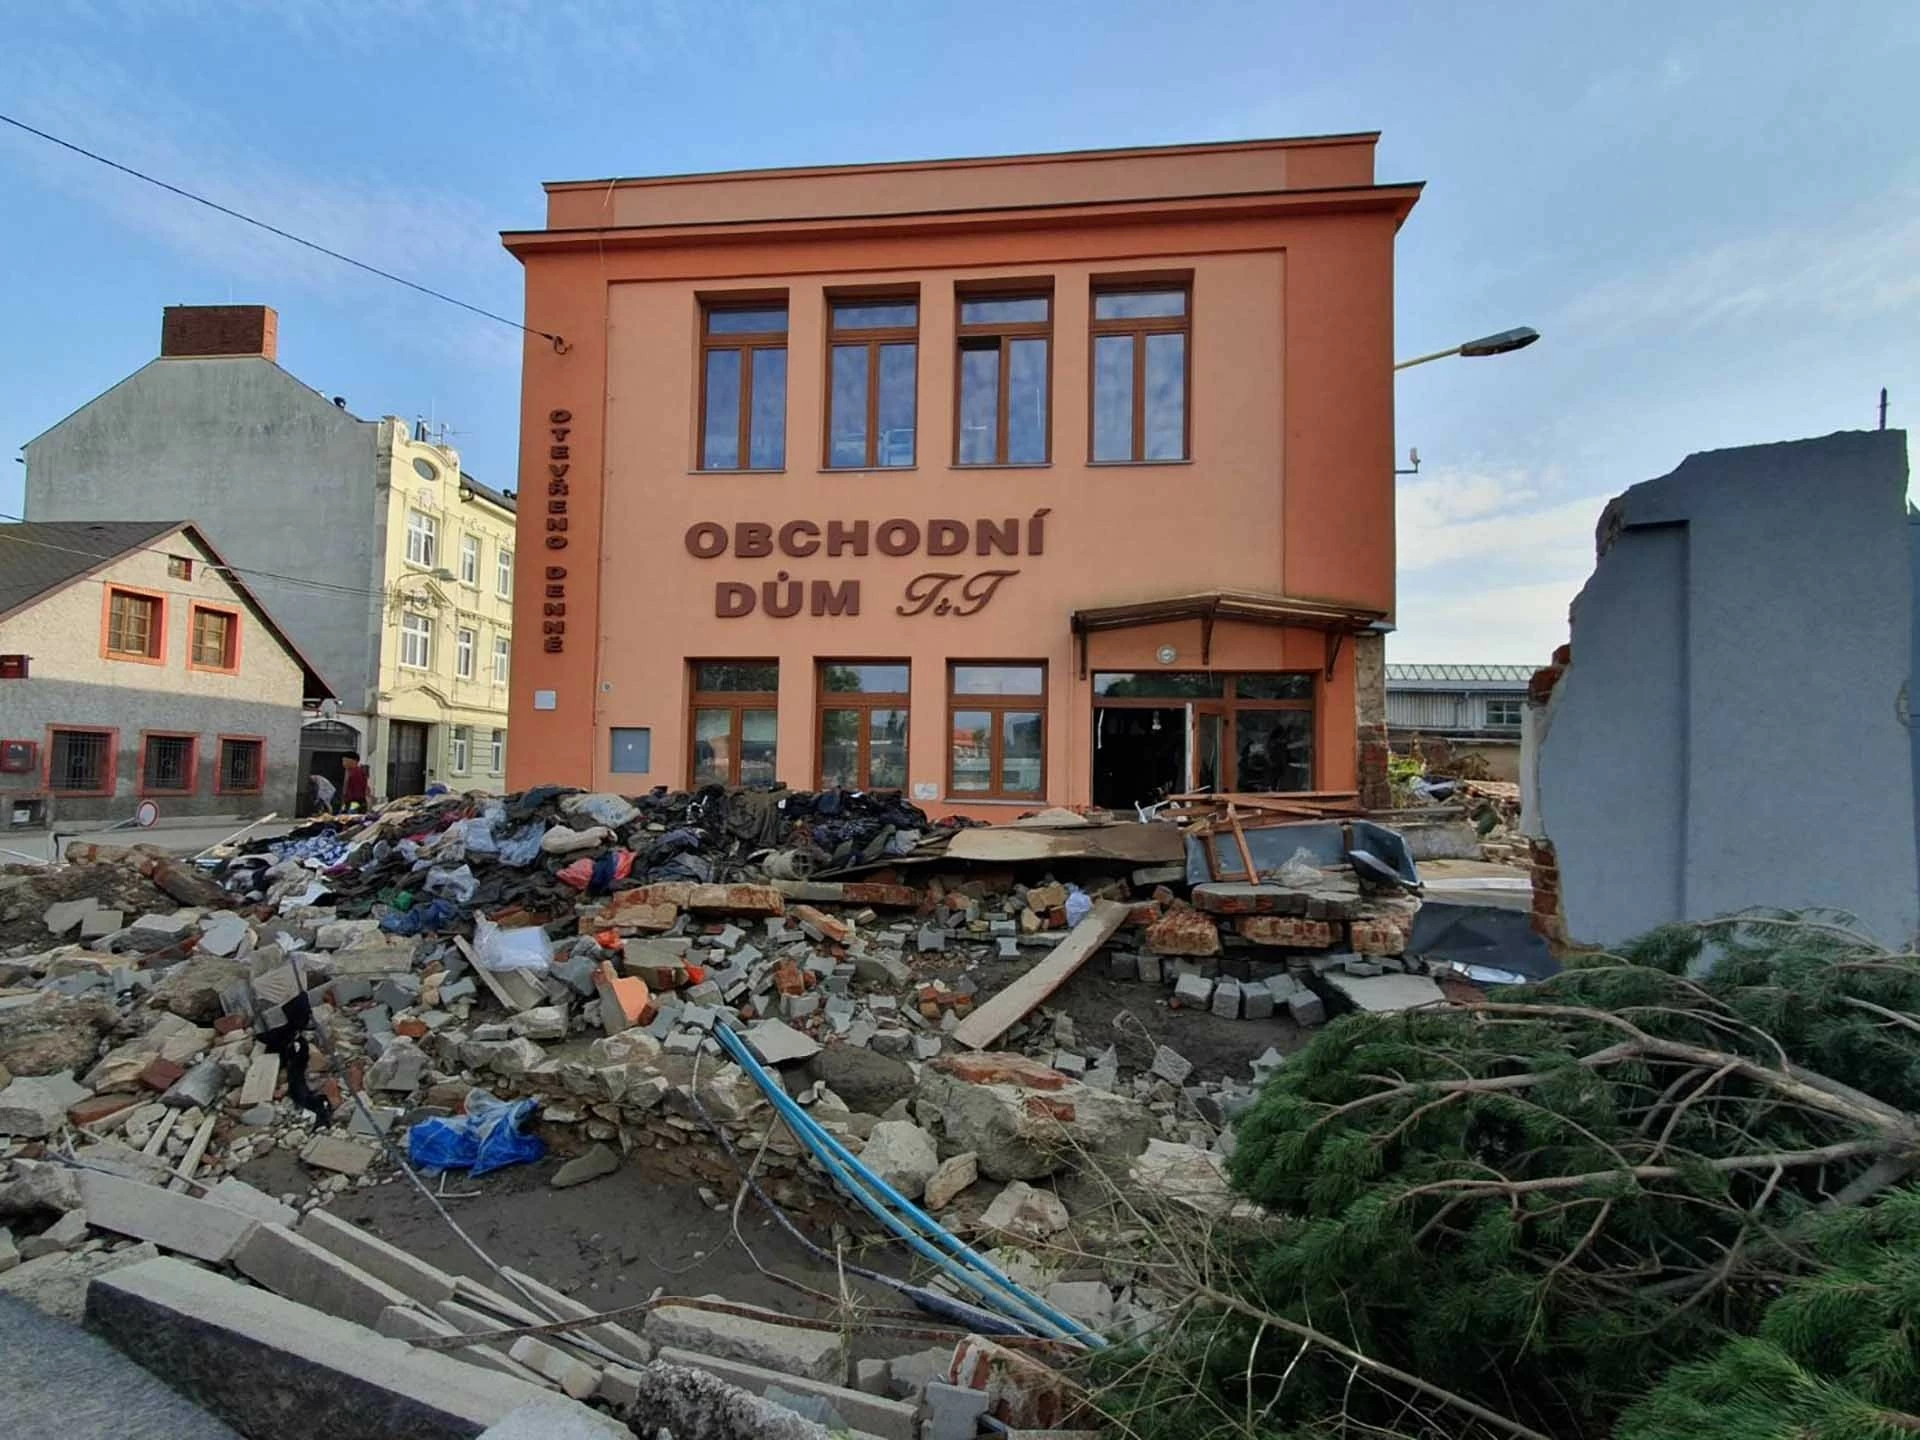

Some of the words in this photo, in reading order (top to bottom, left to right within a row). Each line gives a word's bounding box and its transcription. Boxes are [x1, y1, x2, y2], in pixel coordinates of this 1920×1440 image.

[545, 408, 572, 550] OTEVŘENO
[684, 508, 1052, 559] OBCHODNÍ
[714, 571, 861, 618] DŮM
